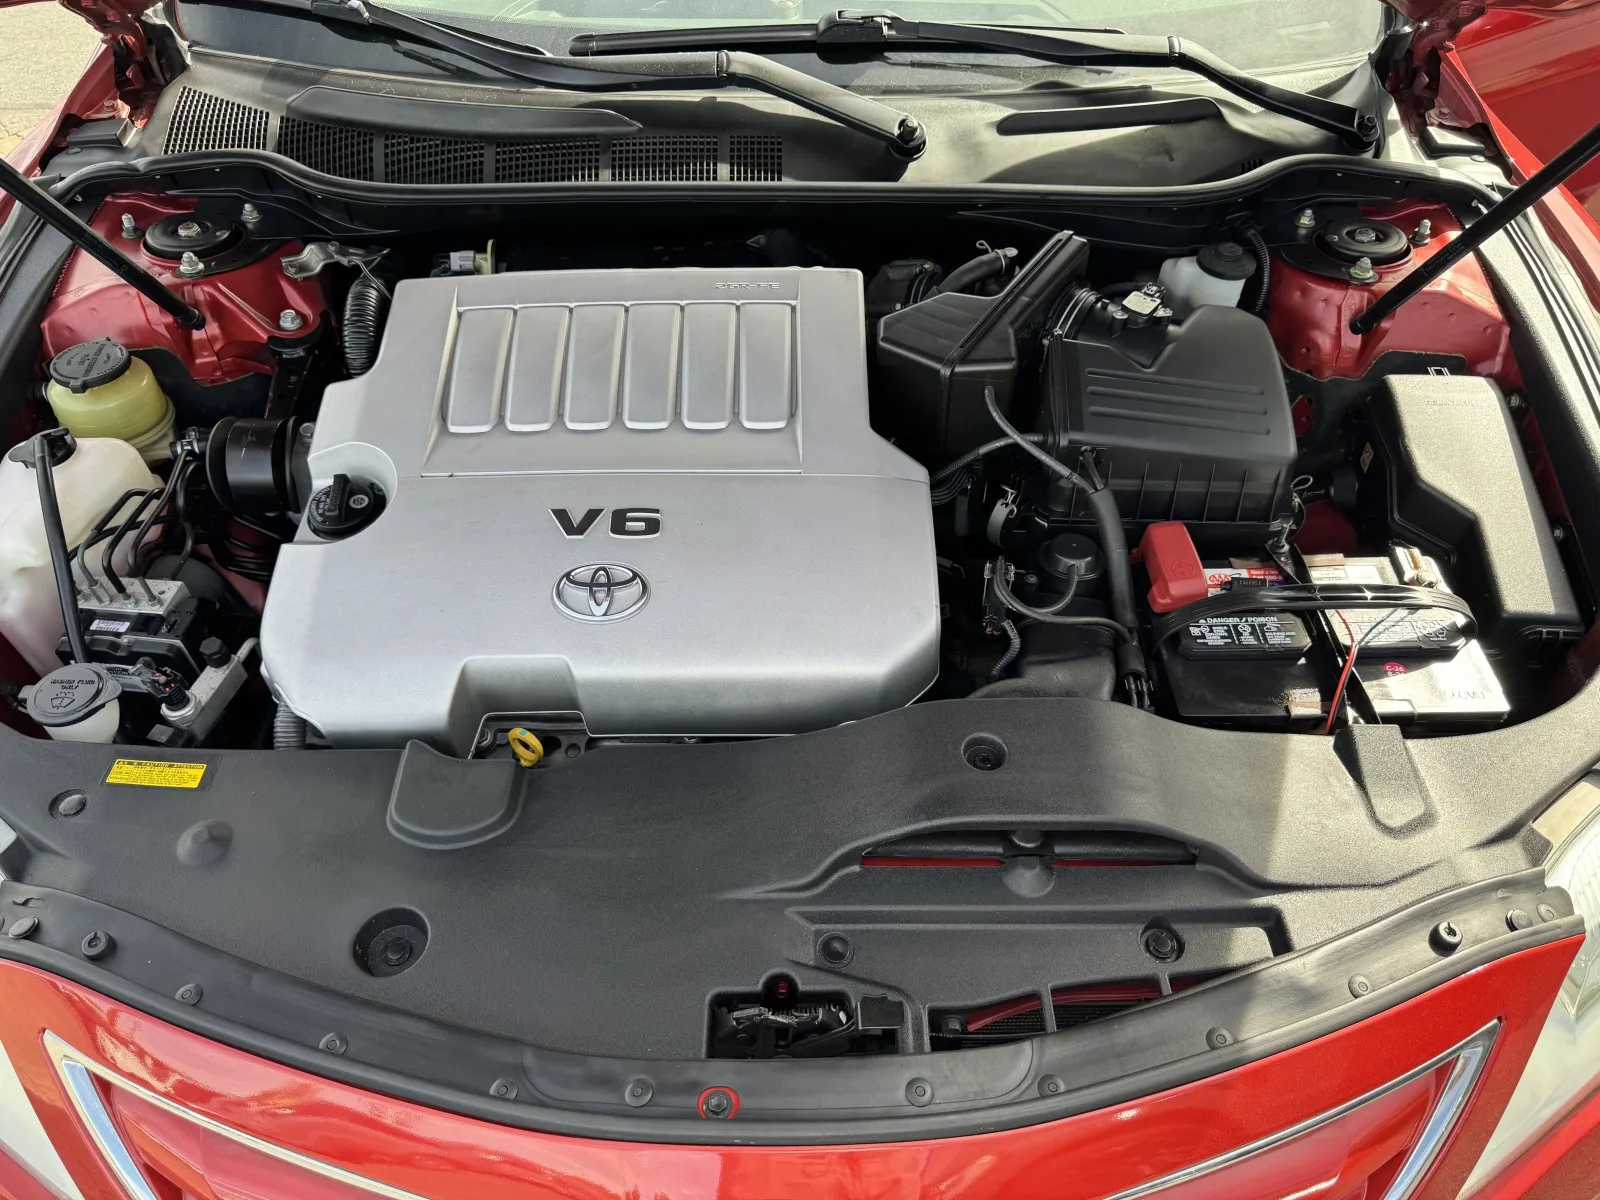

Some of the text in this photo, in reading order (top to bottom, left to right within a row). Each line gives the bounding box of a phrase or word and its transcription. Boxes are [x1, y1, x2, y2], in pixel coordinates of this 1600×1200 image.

[715, 282, 780, 290] 2GR-FE
[548, 508, 661, 539] V6
[1211, 574, 1231, 583] AAA
